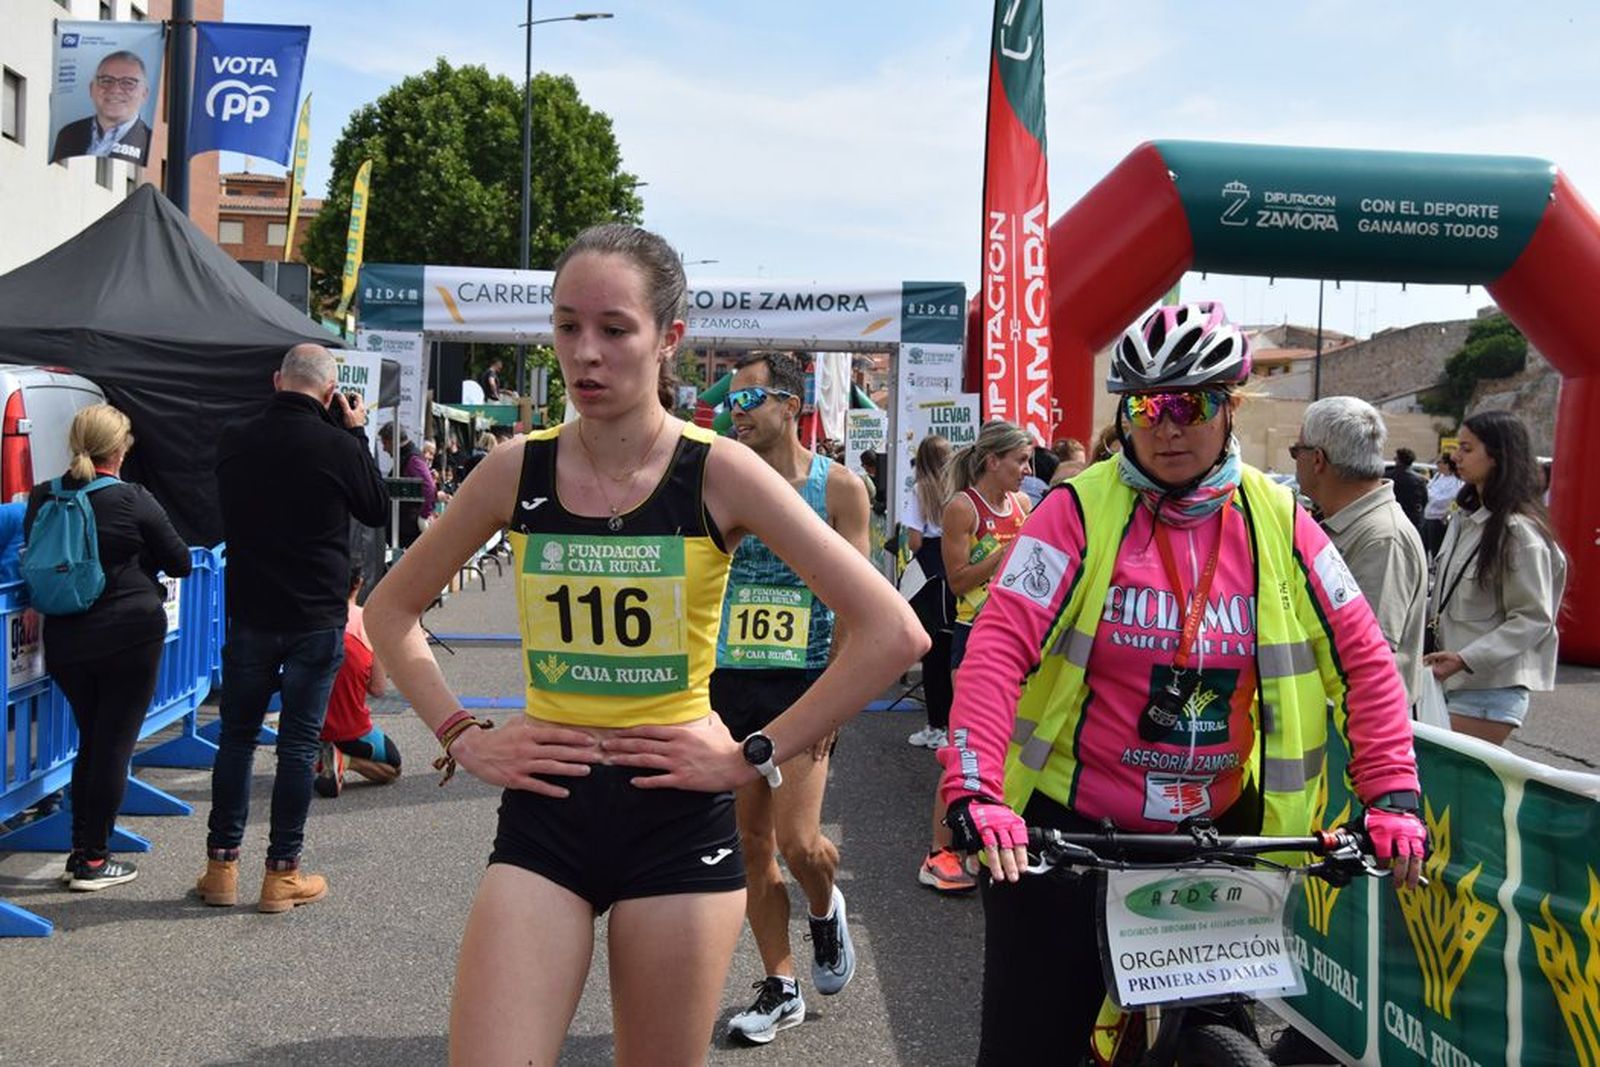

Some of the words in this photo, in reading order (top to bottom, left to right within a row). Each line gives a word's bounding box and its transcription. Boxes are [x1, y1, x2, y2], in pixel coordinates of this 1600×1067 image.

[212, 56, 278, 77] VOTA
[1360, 198, 1395, 214] CON
[1400, 200, 1418, 215] EL
[1423, 201, 1499, 219] DEPORTE
[1256, 210, 1339, 231] ZAMORA
[1358, 218, 1438, 236] GANAMOS
[1443, 222, 1499, 239] TODOS
[457, 282, 553, 305] CARRER
[722, 291, 752, 310] DE
[759, 293, 869, 312] ZAMORA
[701, 317, 761, 330] ZAMORA
[352, 365, 369, 385] UN
[931, 407, 971, 424] LLEVAR
[950, 426, 976, 442] HIJA
[568, 544, 661, 559] FUNDACION
[568, 558, 604, 573] CAJA
[609, 559, 661, 573] RURAL
[546, 584, 652, 648] 116
[737, 609, 795, 642] 163
[571, 665, 612, 683] CAJA
[616, 667, 678, 684] RURAL
[1119, 933, 1281, 971] ORGANIZACIÓN
[1128, 969, 1217, 992] PRIMERAS
[1219, 962, 1279, 986] DAMAS
[1312, 947, 1363, 1011] RURAL
[1384, 1000, 1428, 1059] CAJA
[1430, 1030, 1483, 1067] RUR
